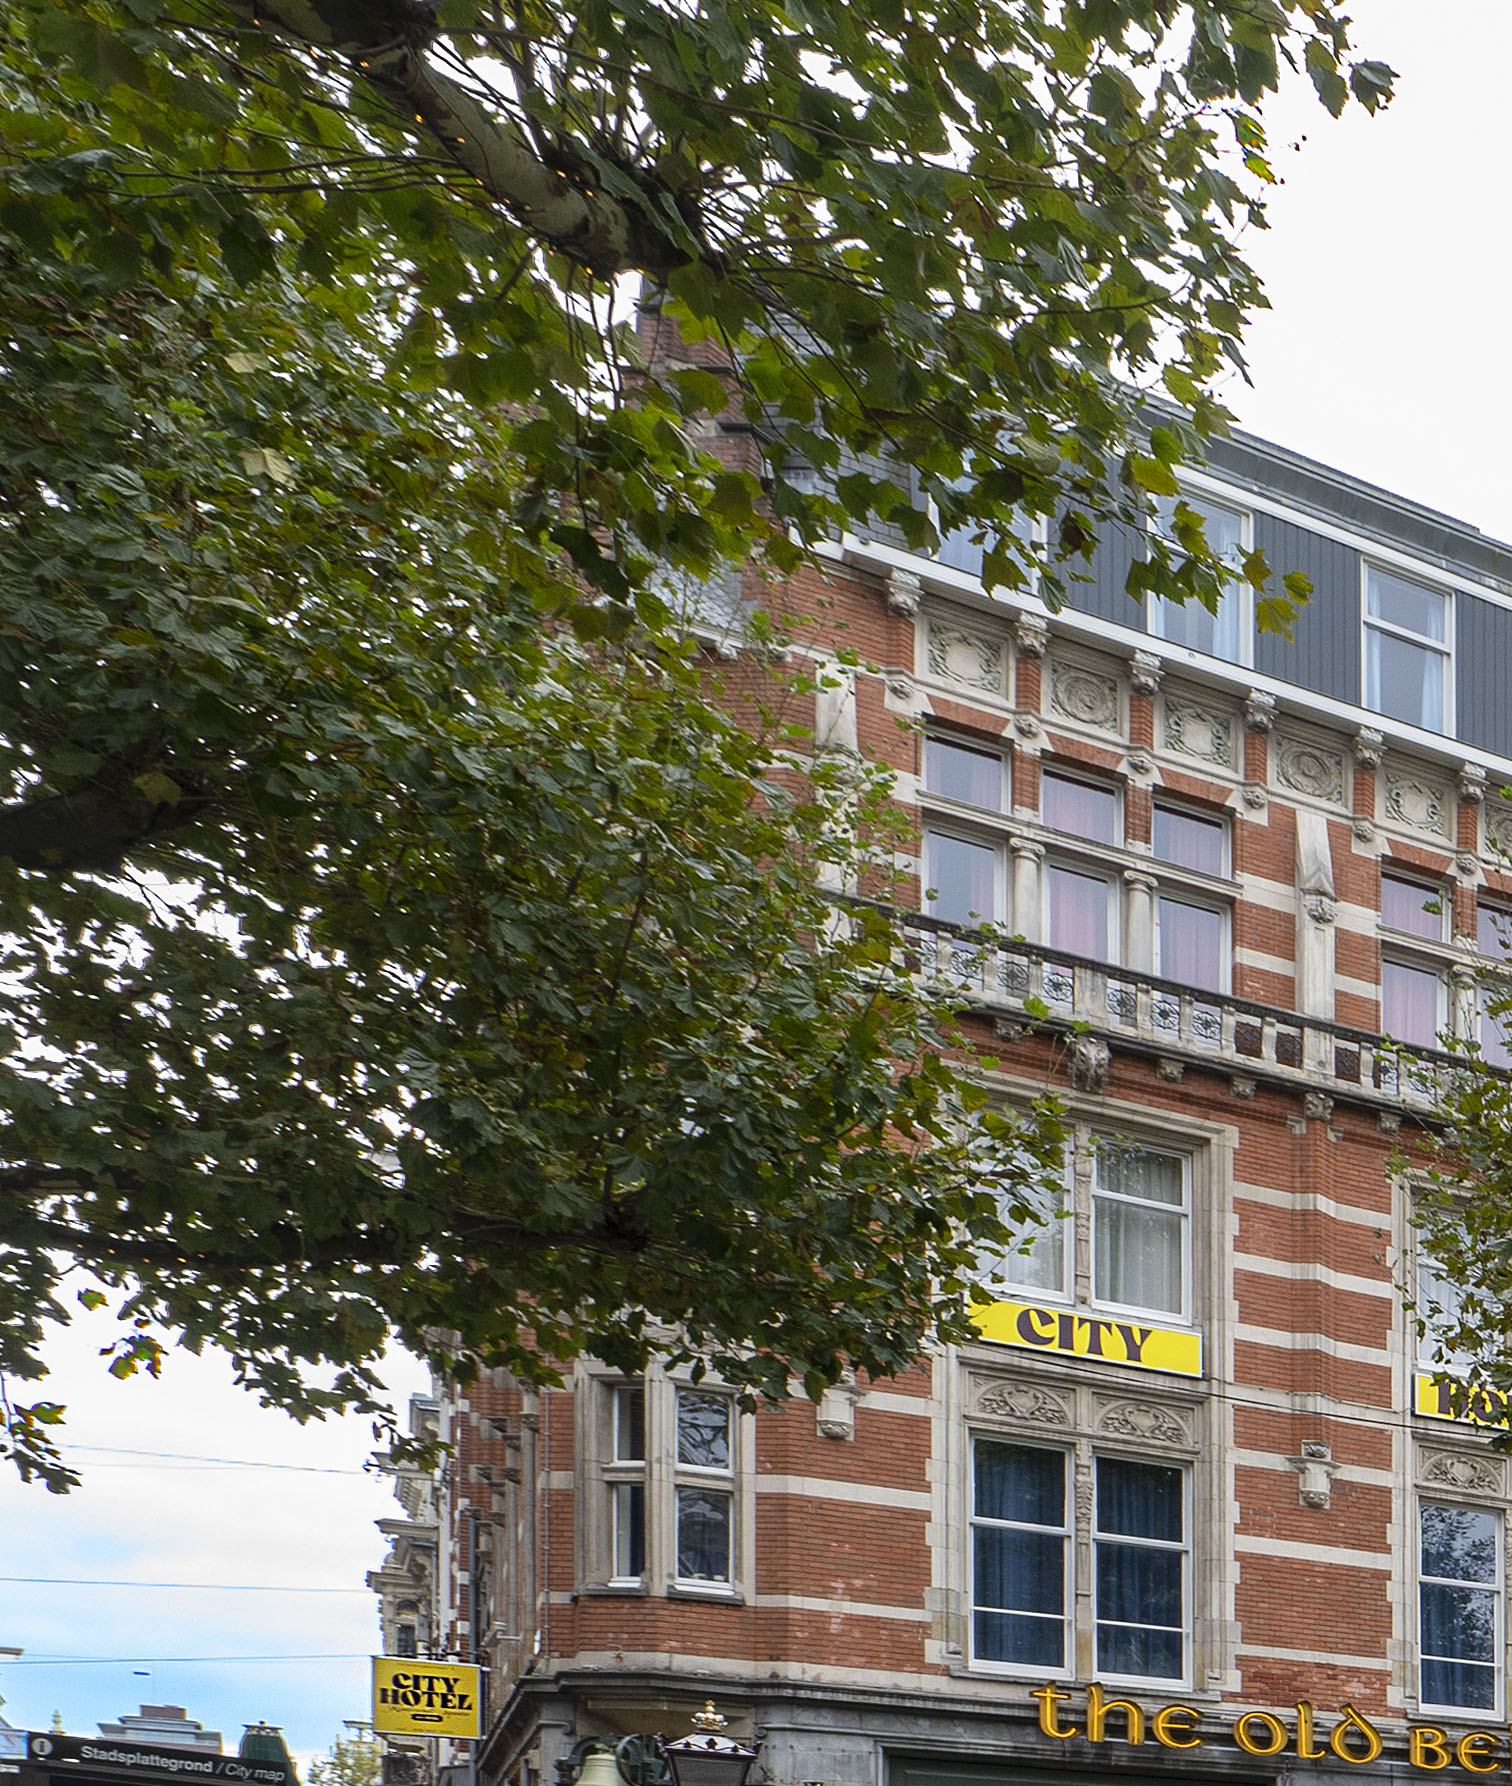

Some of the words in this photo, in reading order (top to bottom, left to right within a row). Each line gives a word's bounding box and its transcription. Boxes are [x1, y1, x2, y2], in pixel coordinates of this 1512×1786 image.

[1016, 1308, 1153, 1362] CITY
[392, 1673, 460, 1692] CITY
[380, 1688, 472, 1711] HOTEL
[81, 1745, 213, 1773] Stadsplattegrond
[225, 1763, 252, 1780] City
[254, 1766, 285, 1783] map
